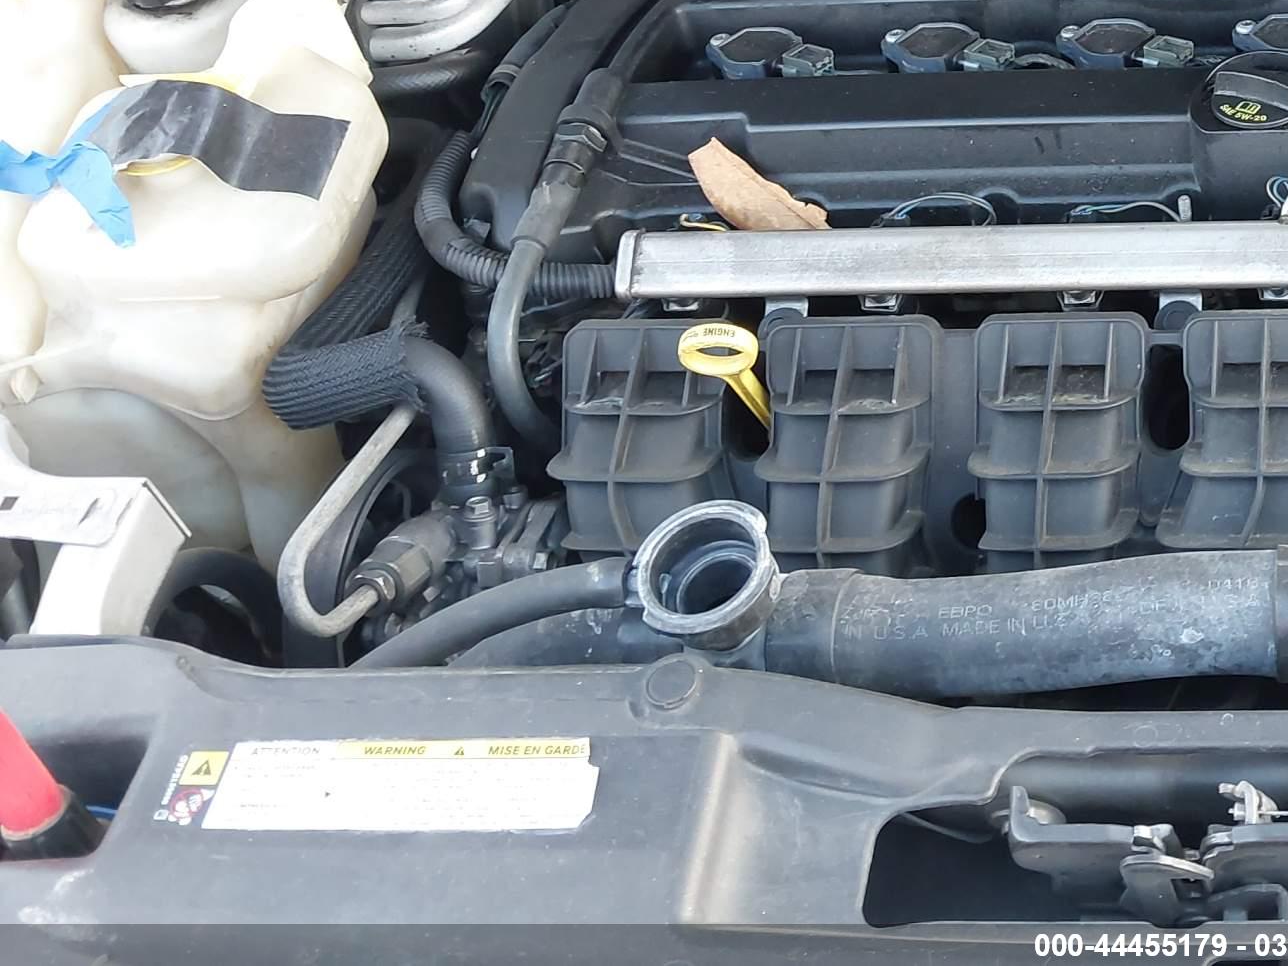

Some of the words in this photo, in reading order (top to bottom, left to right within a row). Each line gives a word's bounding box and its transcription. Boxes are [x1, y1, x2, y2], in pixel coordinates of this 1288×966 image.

[1220, 104, 1236, 116] SAE
[1235, 113, 1267, 122] 5W-20
[703, 327, 736, 338] ENGINE
[942, 618, 1001, 636] MADE
[1007, 617, 1027, 636] IN
[364, 746, 427, 755] WARNING
[488, 745, 520, 755] MISE
[524, 745, 541, 755] EN
